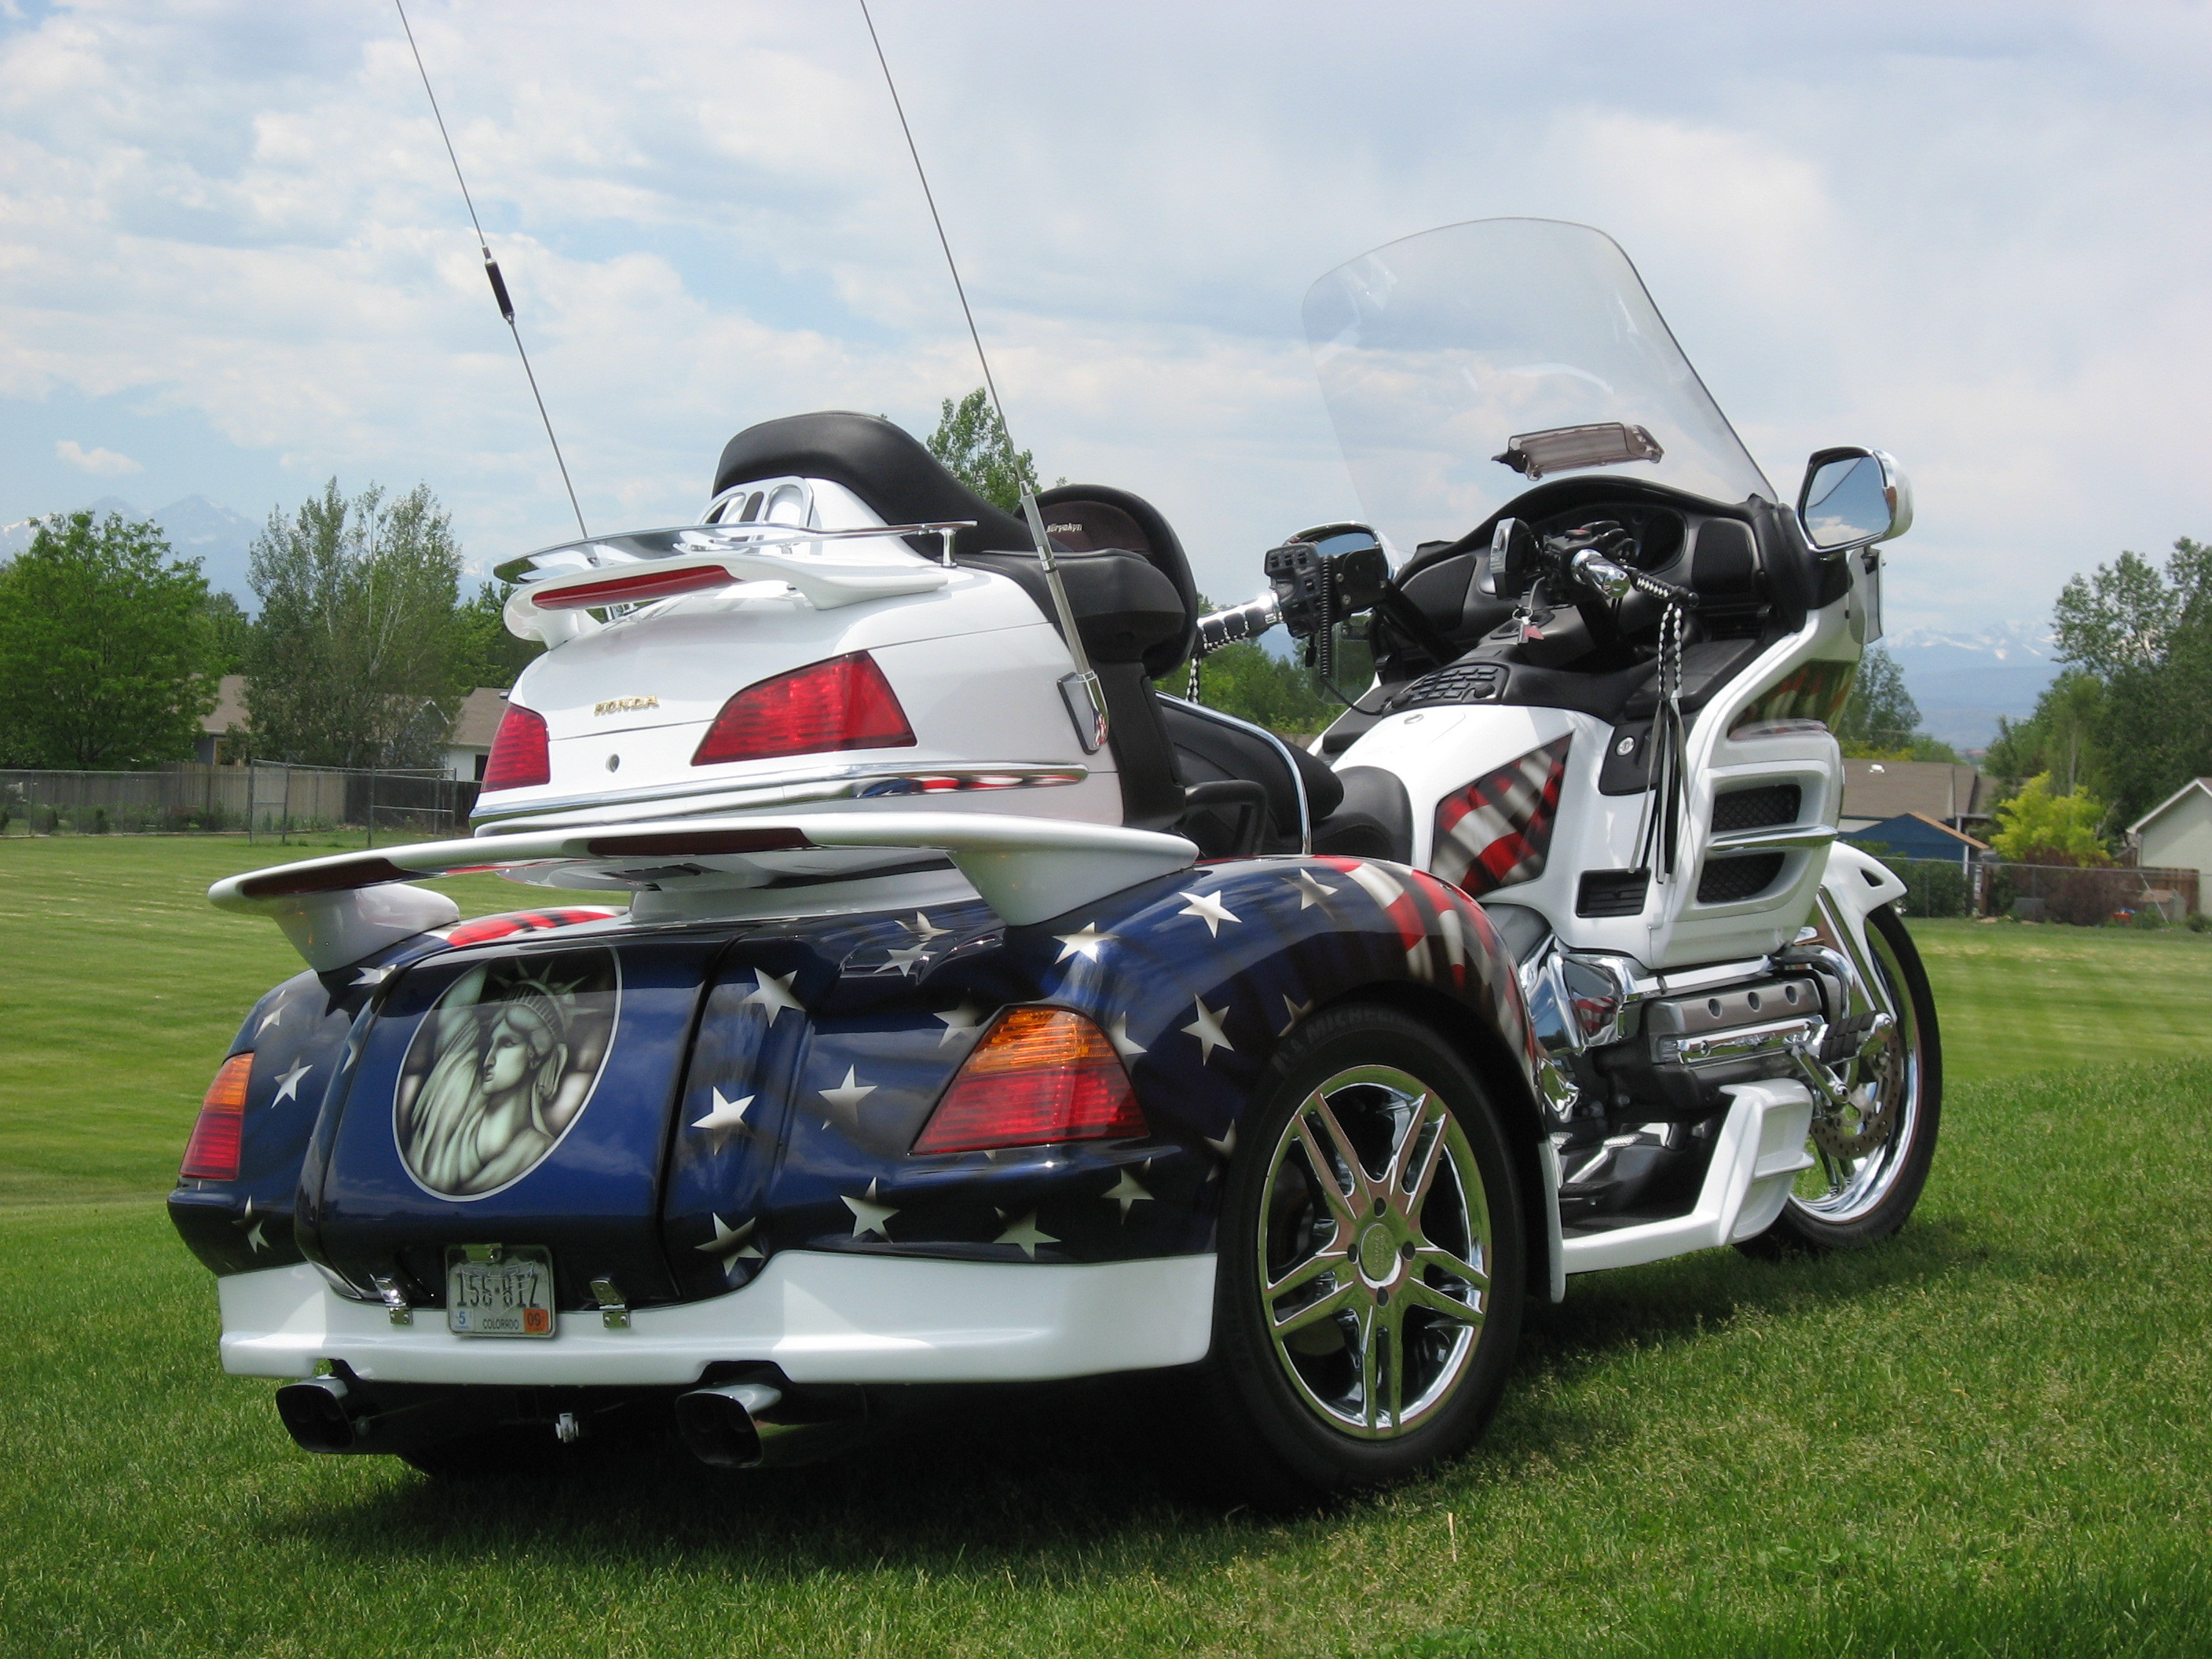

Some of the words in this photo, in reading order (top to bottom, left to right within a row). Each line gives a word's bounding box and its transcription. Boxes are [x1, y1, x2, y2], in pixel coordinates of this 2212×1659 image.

[593, 694, 660, 716] HONDA
[459, 1312, 466, 1325] 5
[482, 1318, 519, 1330] COLORADO
[527, 1313, 541, 1326] 09
